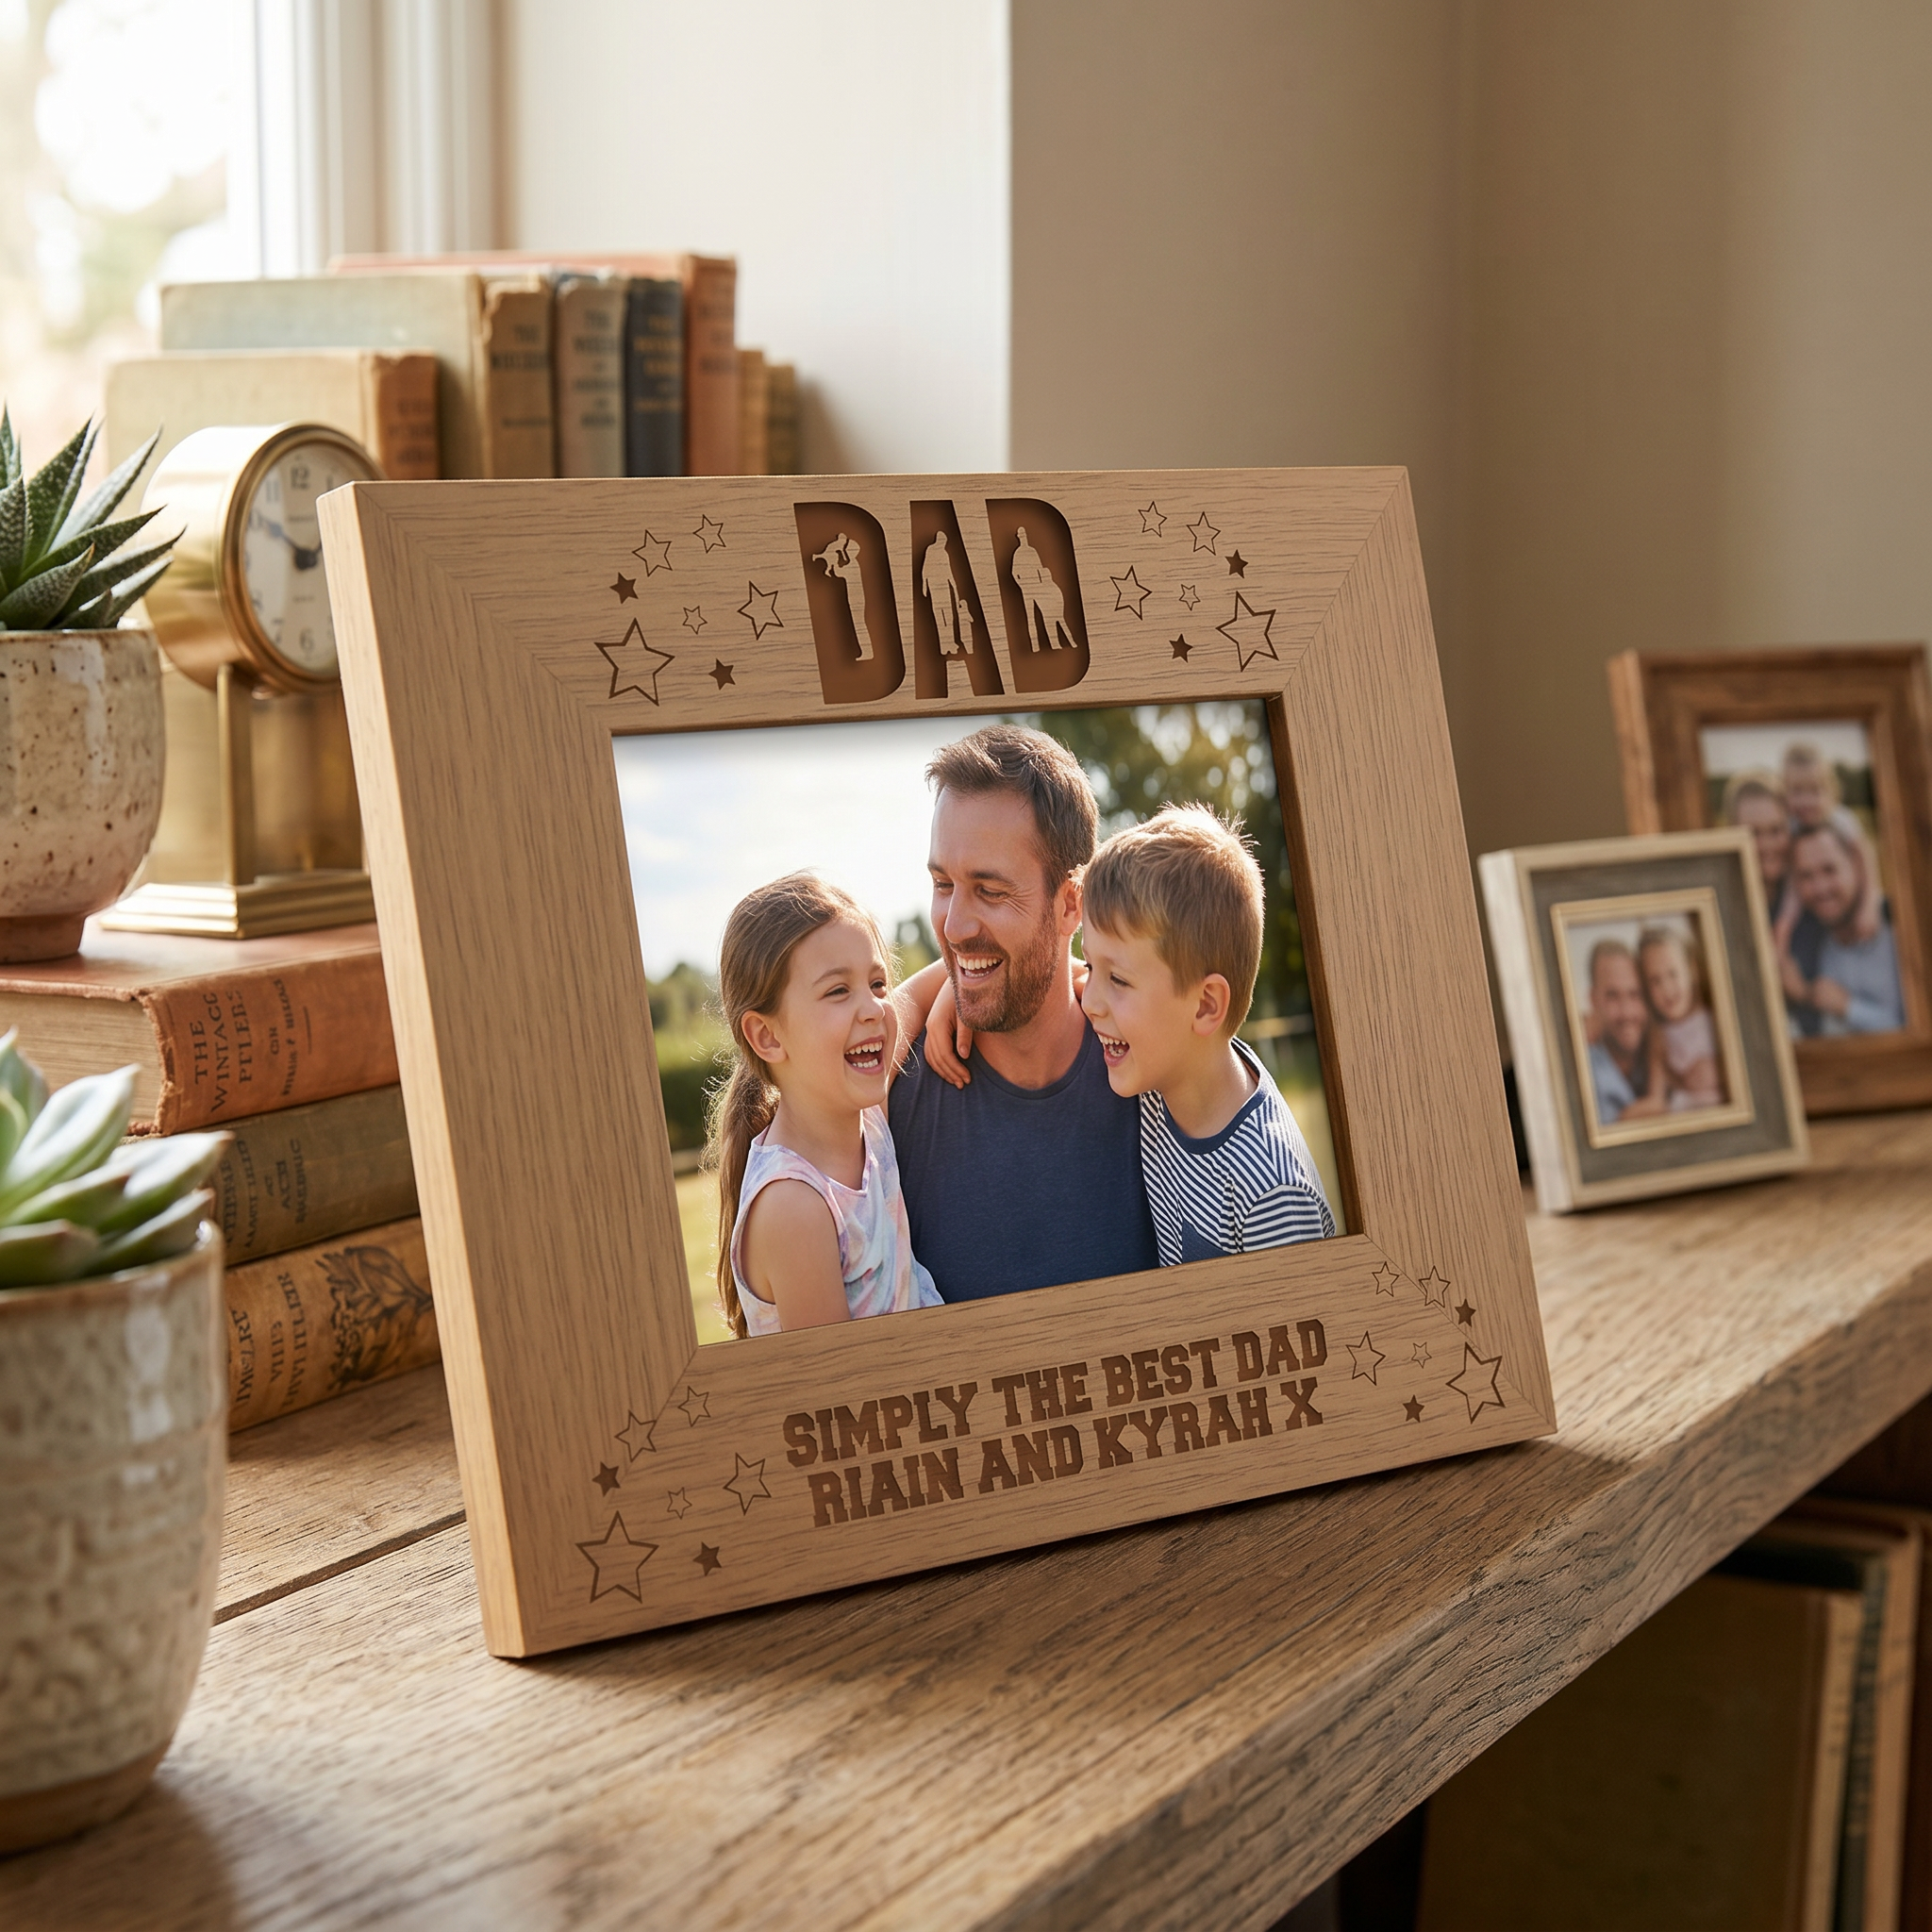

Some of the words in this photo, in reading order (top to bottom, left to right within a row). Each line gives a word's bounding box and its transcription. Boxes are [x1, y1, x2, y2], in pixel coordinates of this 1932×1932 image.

[291, 465, 310, 490] 12
[793, 497, 1091, 705] DAD
[190, 1020, 208, 1084] THE
[782, 1381, 979, 1469] SIMPLY
[991, 1360, 1093, 1427] THE
[1101, 1337, 1221, 1407] BEST
[1231, 1319, 1328, 1383] DAD
[808, 1447, 965, 1528] RIAIN
[977, 1424, 1085, 1494] AND
[1091, 1387, 1274, 1470] KYRAH
[1279, 1376, 1324, 1431] X
